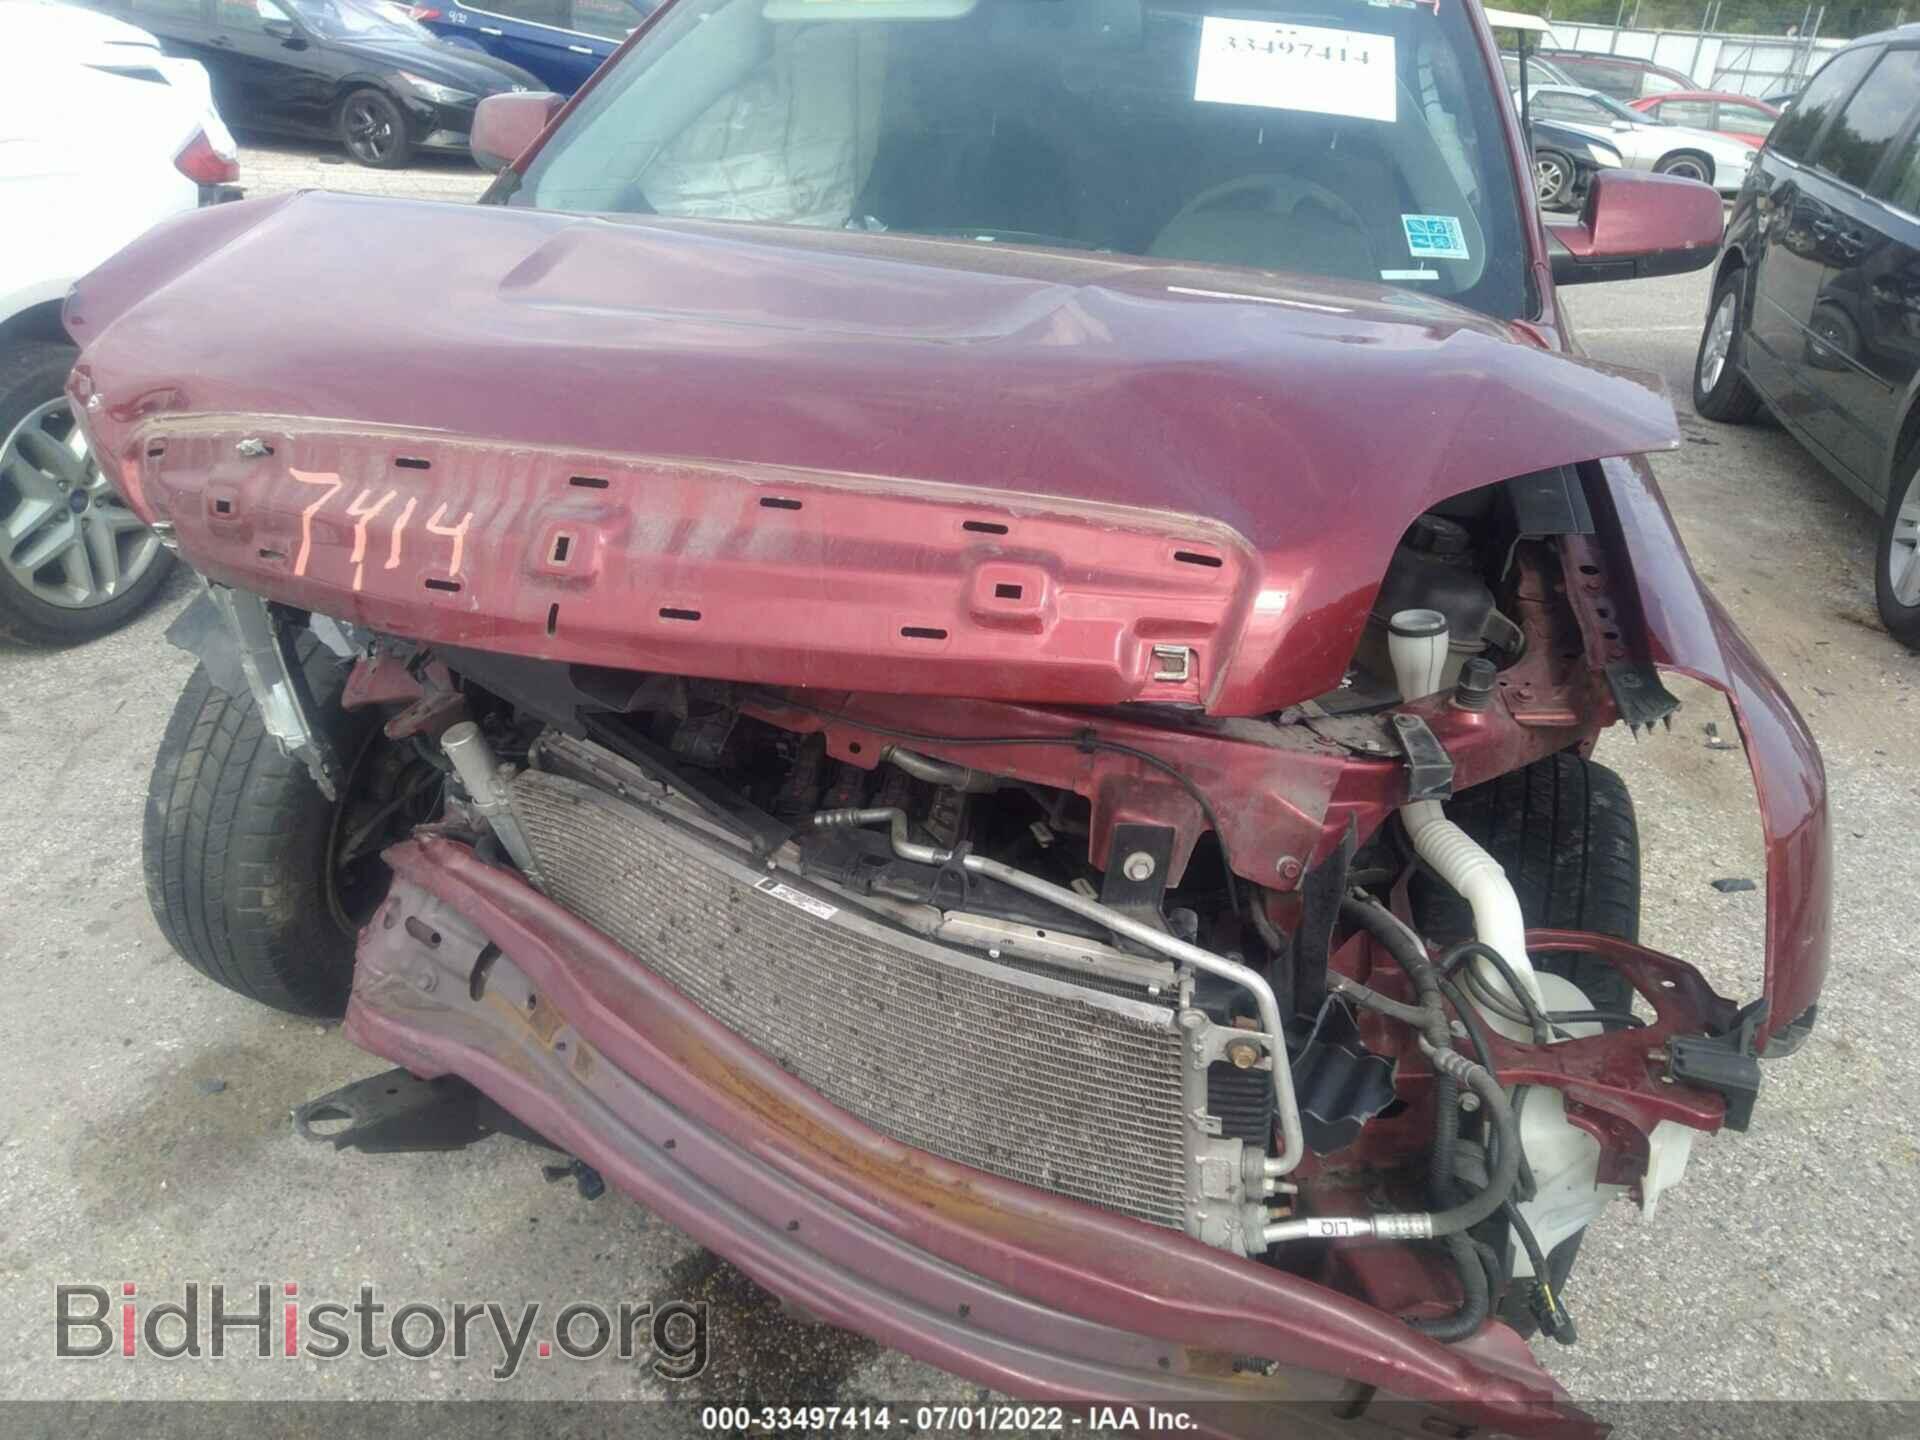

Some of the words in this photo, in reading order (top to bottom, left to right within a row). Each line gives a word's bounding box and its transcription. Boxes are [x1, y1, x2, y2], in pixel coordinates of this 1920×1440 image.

[1226, 35, 1370, 65] 33497414
[288, 467, 475, 592] 7414
[1320, 1220, 1350, 1236] LIQ
